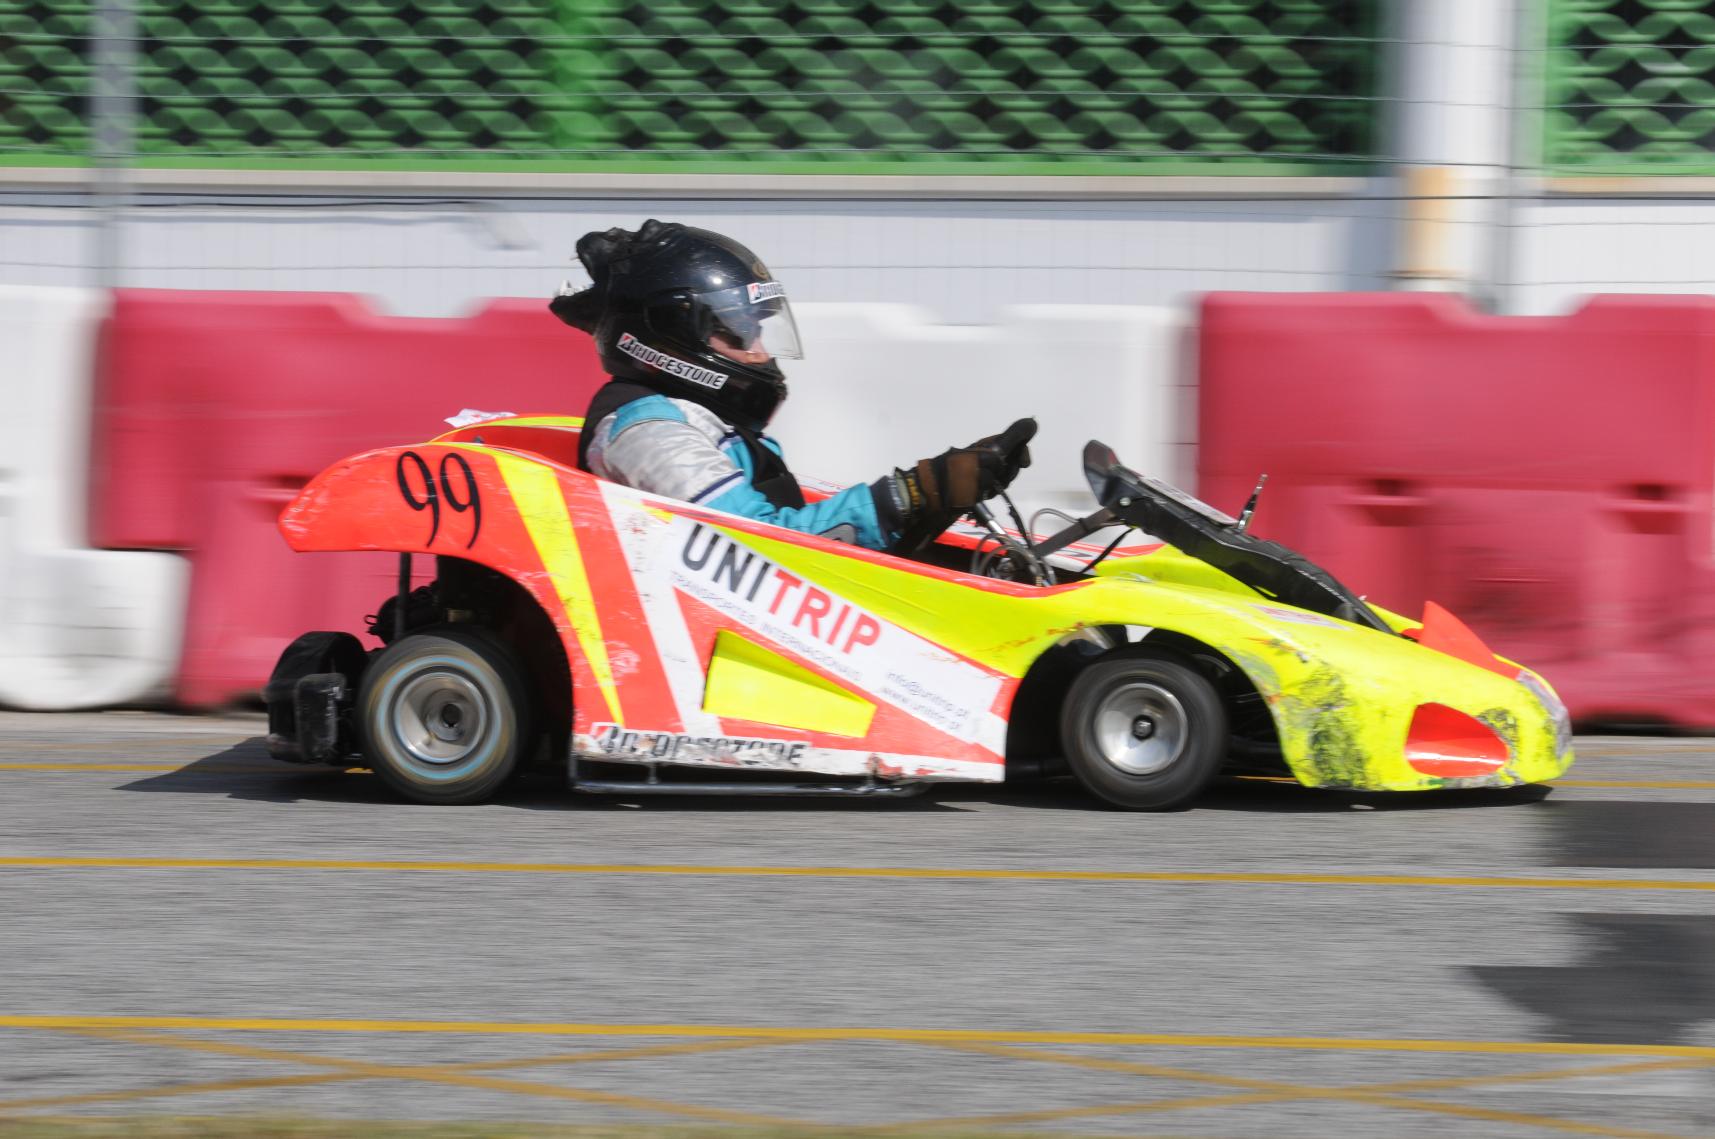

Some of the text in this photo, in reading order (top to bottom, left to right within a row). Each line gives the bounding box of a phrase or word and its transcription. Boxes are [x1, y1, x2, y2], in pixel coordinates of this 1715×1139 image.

[618, 335, 725, 388] BRIDGESTONE
[396, 451, 482, 549] 99
[682, 523, 881, 655] UNITRIP
